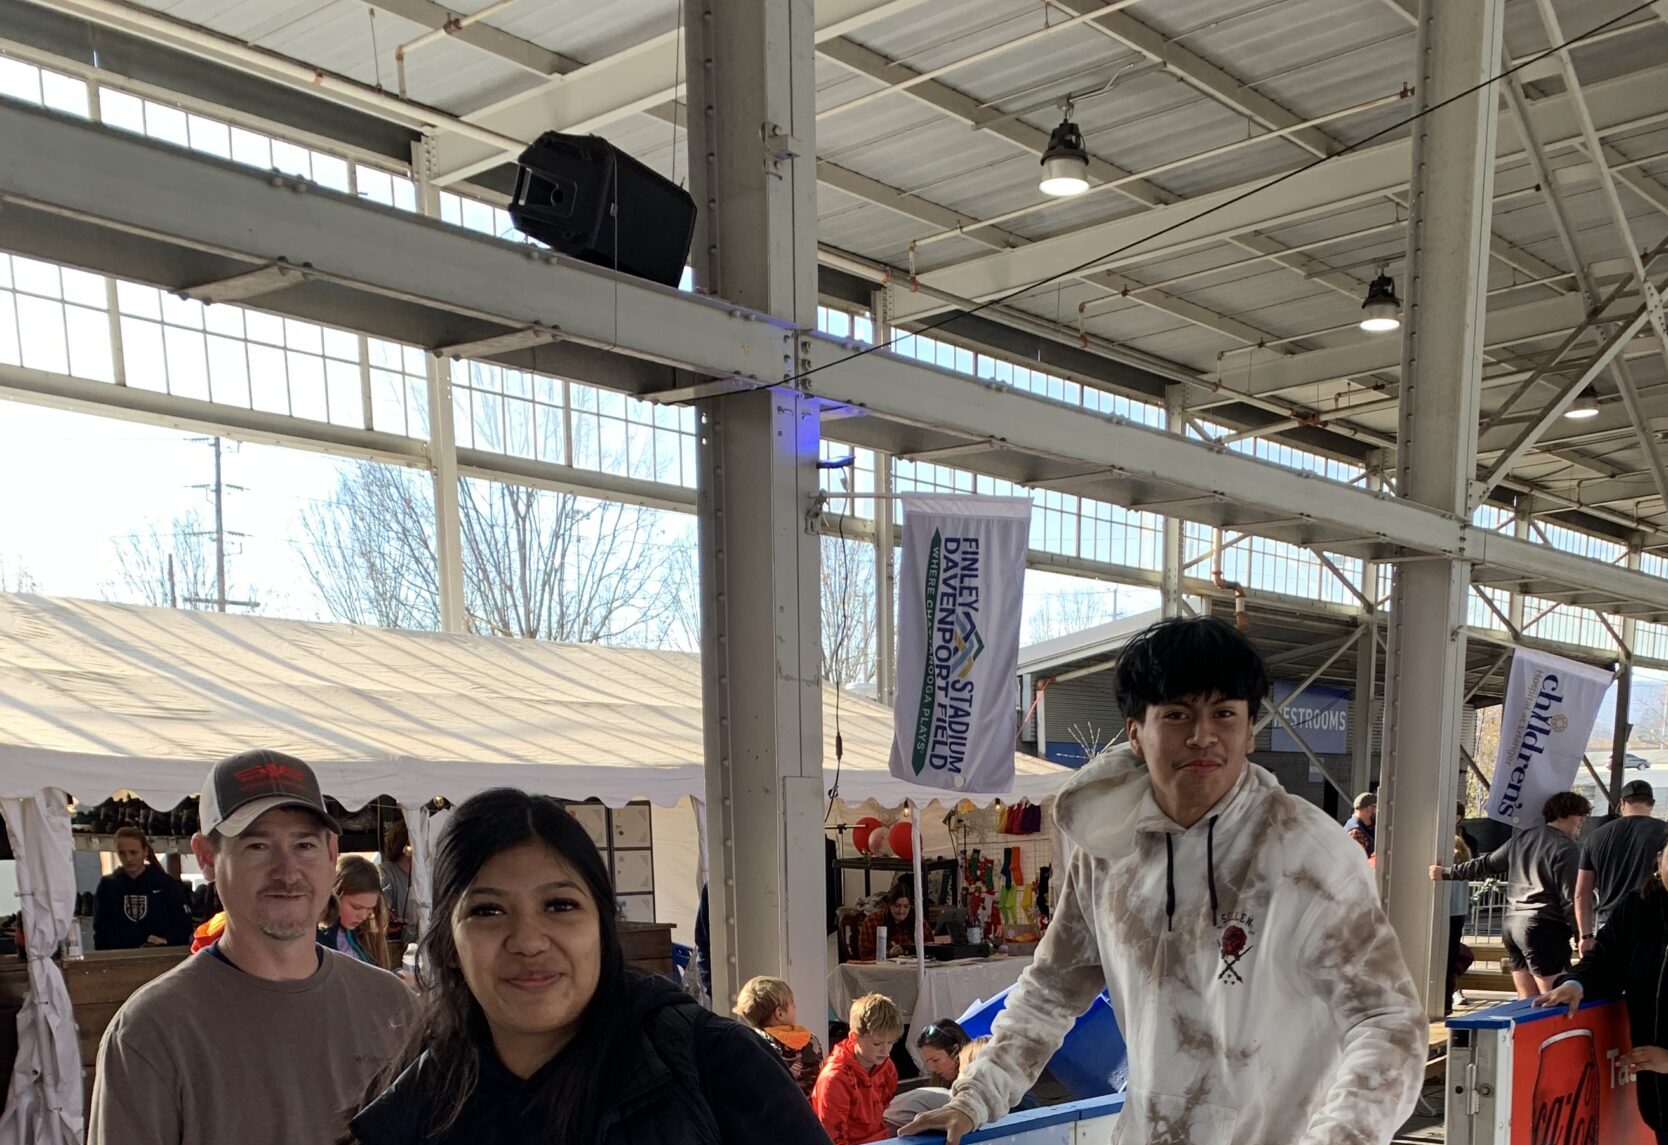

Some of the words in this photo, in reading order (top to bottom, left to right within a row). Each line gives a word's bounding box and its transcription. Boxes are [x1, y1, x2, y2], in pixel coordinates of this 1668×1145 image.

[927, 546, 940, 596] WHERE
[958, 537, 979, 613] FINLEY
[923, 600, 935, 703] CHANOOGA
[935, 537, 961, 699] DAVENPORT
[947, 678, 975, 774] STADIUM
[1523, 669, 1544, 710] Hospital
[929, 702, 948, 770] FIELD
